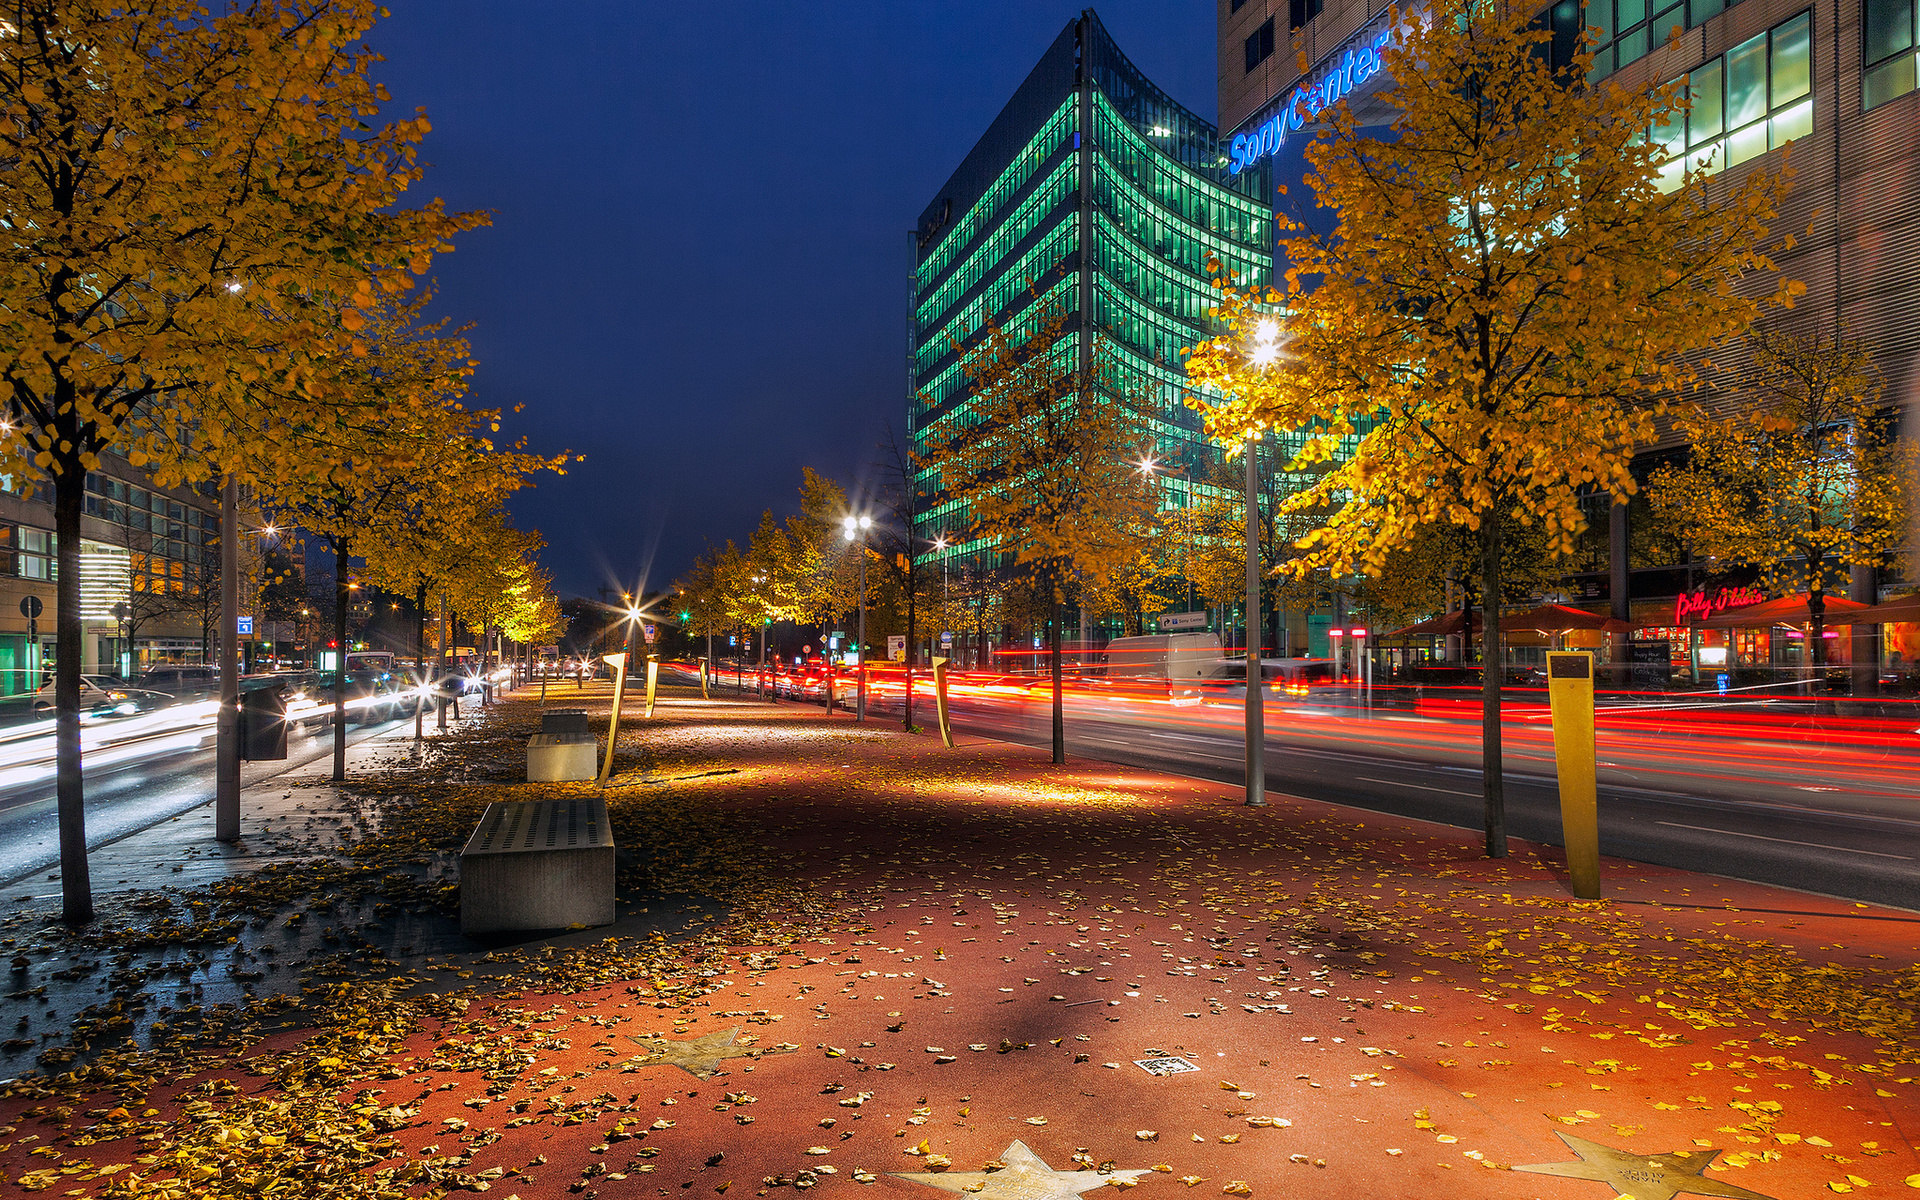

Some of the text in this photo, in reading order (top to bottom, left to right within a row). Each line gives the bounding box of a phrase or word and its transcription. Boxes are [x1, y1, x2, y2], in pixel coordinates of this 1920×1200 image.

[1676, 586, 1762, 625] Billy Wlder's
[1623, 1174, 1660, 1184] HANS
